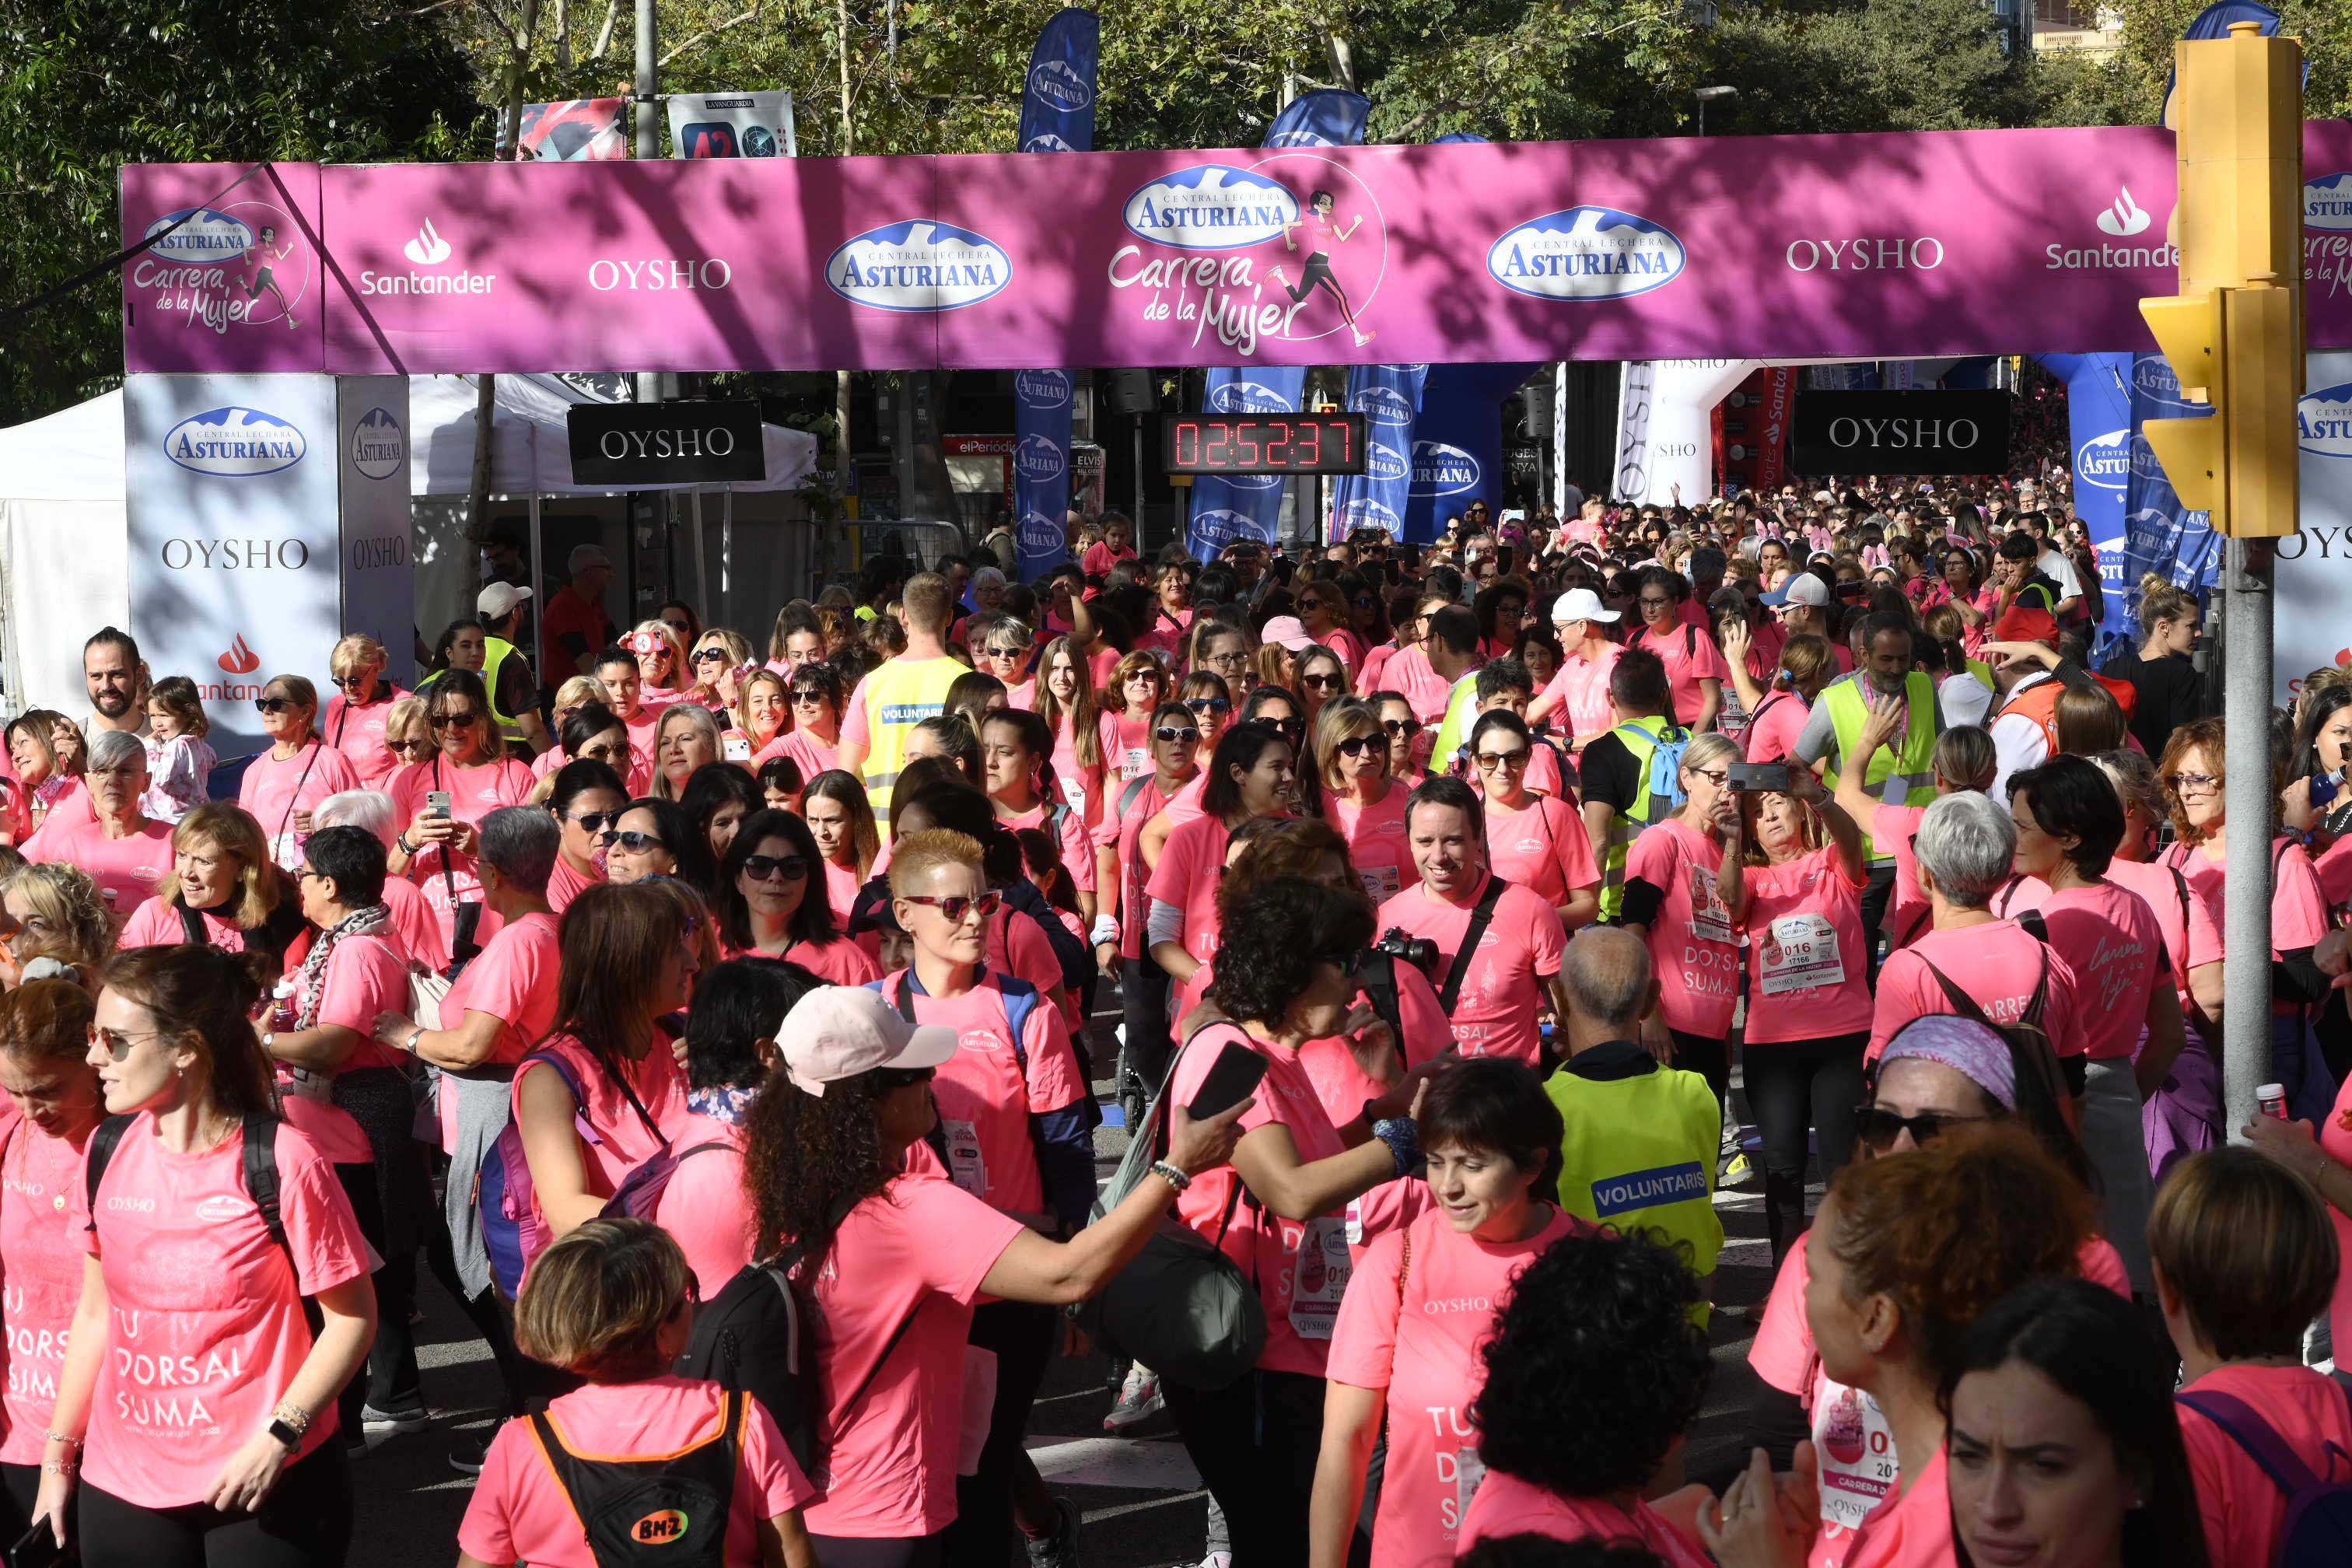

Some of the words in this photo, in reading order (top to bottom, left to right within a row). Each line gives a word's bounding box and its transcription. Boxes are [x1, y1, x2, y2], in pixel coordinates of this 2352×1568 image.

[1136, 196, 1285, 229] ASTURIANA
[1163, 193, 1220, 204] CENTRAL
[1225, 192, 1281, 203] LECHERA
[869, 250, 928, 261] CENTRAL
[1532, 239, 1594, 250] CENTRAL
[1600, 237, 1664, 248] LECHERA
[1787, 236, 1944, 272] OYSHO
[134, 260, 226, 289] Carrera
[588, 258, 732, 290] OYSHO
[840, 260, 999, 289] ASTURIANA
[1108, 245, 1253, 289] Carrera
[1503, 247, 1669, 278] ASTURIANA
[361, 270, 495, 295] Santander
[156, 292, 175, 310] de
[177, 291, 189, 311] la
[187, 285, 259, 334] Mujer
[1143, 291, 1170, 320] de
[1177, 290, 1195, 320] la
[1192, 283, 1307, 356] Mujer
[175, 432, 297, 459] ASTURIANA
[246, 430, 292, 439] LECHERA
[600, 427, 735, 460] OYSHO
[1177, 422, 1349, 467] 02:52:37
[1829, 417, 1979, 449] OYSHO
[355, 434, 401, 463] ASTURIANA
[1077, 456, 1101, 466] ELVIS
[2083, 452, 2130, 474] ASTU
[161, 538, 310, 570] OYSHO
[353, 535, 405, 571] OYSHO
[198, 680, 267, 702] antan
[1784, 942, 1811, 957] 016
[1789, 956, 1810, 965] 17166
[1684, 971, 1734, 996] SUMA
[1596, 1171, 1706, 1207] VOLUNTARIS
[107, 1196, 156, 1213] OYSHO
[1424, 1296, 1489, 1315] OYSHO
[117, 1346, 243, 1387] DORSAL
[116, 1390, 214, 1427] SUMA
[1838, 1477, 1878, 1494] CARRERA
